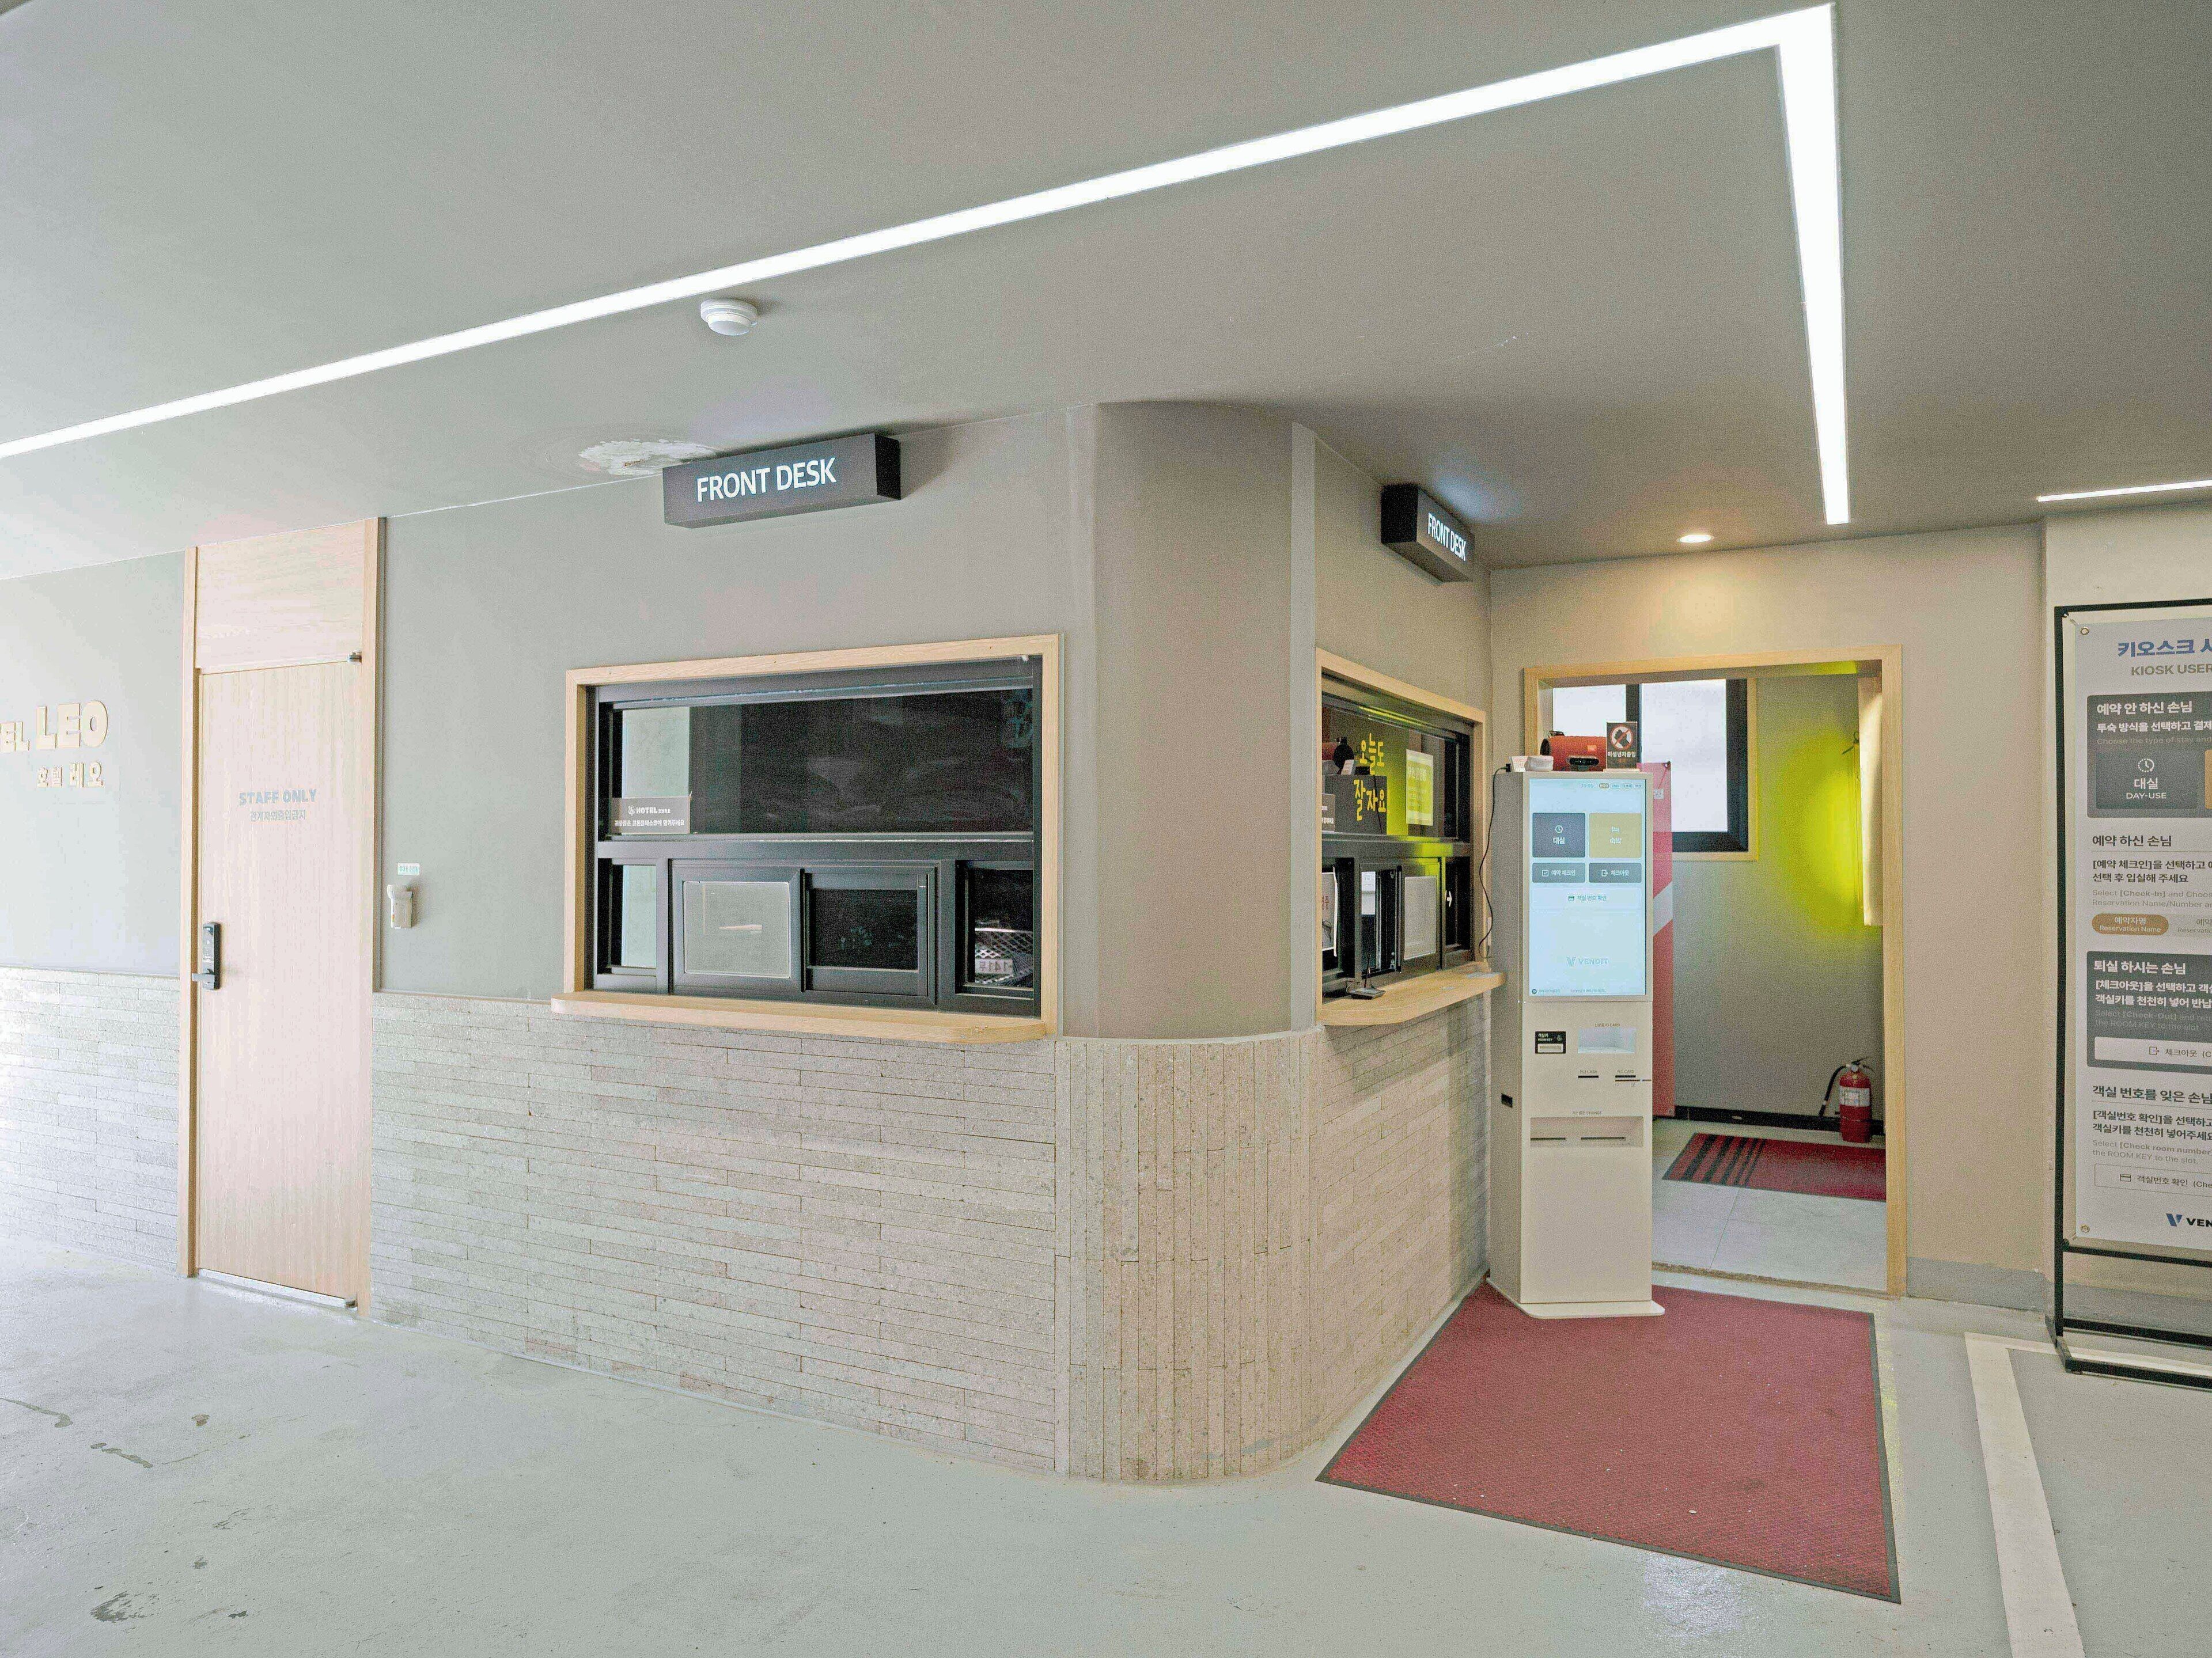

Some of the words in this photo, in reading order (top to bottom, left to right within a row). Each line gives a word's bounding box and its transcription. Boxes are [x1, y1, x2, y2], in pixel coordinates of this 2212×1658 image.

[697, 468, 770, 502] FRONT
[777, 457, 836, 491] DESK
[1428, 513, 1450, 548] FRONT
[1450, 531, 1466, 561] DESK
[2118, 639, 2195, 657] 키오스크
[2131, 665, 2174, 676] KIOSK
[2097, 703, 2122, 715] 예약
[2124, 703, 2137, 715] 안
[2139, 701, 2164, 714] 하신
[2167, 701, 2192, 714] 손님
[36, 700, 108, 750] LEO
[2097, 723, 2116, 733] 투숙
[2119, 722, 2149, 733] 방식을
[2151, 721, 2191, 731] 선택하고
[1359, 733, 1385, 775] 오늘도
[2134, 777, 2158, 790] 대실
[239, 791, 279, 806] STAFF
[283, 789, 316, 803] ONLY
[1553, 837, 1565, 845] 대실
[2092, 835, 2116, 847] 예약
[2119, 835, 2144, 847] 하신
[2147, 836, 2172, 847] 손님
[2093, 860, 2116, 870] [예약
[2119, 860, 2162, 870] 체크인]을
[2165, 860, 2206, 870] 선택하고
[2093, 873, 2111, 882] 선택
[2114, 873, 2124, 882] 후
[2127, 873, 2156, 883] 입실해
[2158, 874, 2188, 883] 주세요
[2142, 900, 2203, 908] Name/Number
[2115, 917, 2146, 925] 예약자명
[2094, 960, 2118, 972] 퇴실
[2121, 961, 2158, 973] 하시는
[2161, 962, 2186, 975] 손님
[2096, 980, 2153, 992] [체크아웃]을
[2156, 982, 2196, 993] 선택하고
[2095, 994, 2134, 1005] 객실키를
[2137, 996, 2166, 1007] 천천히
[2169, 997, 2189, 1008] 넣어
[2165, 1048, 2197, 1057] 체크아웃
[2092, 1086, 2116, 1098] 객실
[2120, 1087, 2157, 1101] 번호를
[2160, 1090, 2185, 1103] 잊은
[2093, 1110, 2136, 1121] [객실번호
[2138, 1112, 2173, 1125] 확인]을
[2092, 1124, 2131, 1135] 객실키를
[2134, 1125, 2164, 1138] 천천히
[2093, 1140, 2118, 1148] Select
[2120, 1141, 2150, 1150] [Check
[2107, 1151, 2134, 1159] ROOM
[2136, 1152, 2152, 1160] KEY
[2137, 1175, 2170, 1185] 객실번호
[2171, 1178, 2188, 1187] 확인
